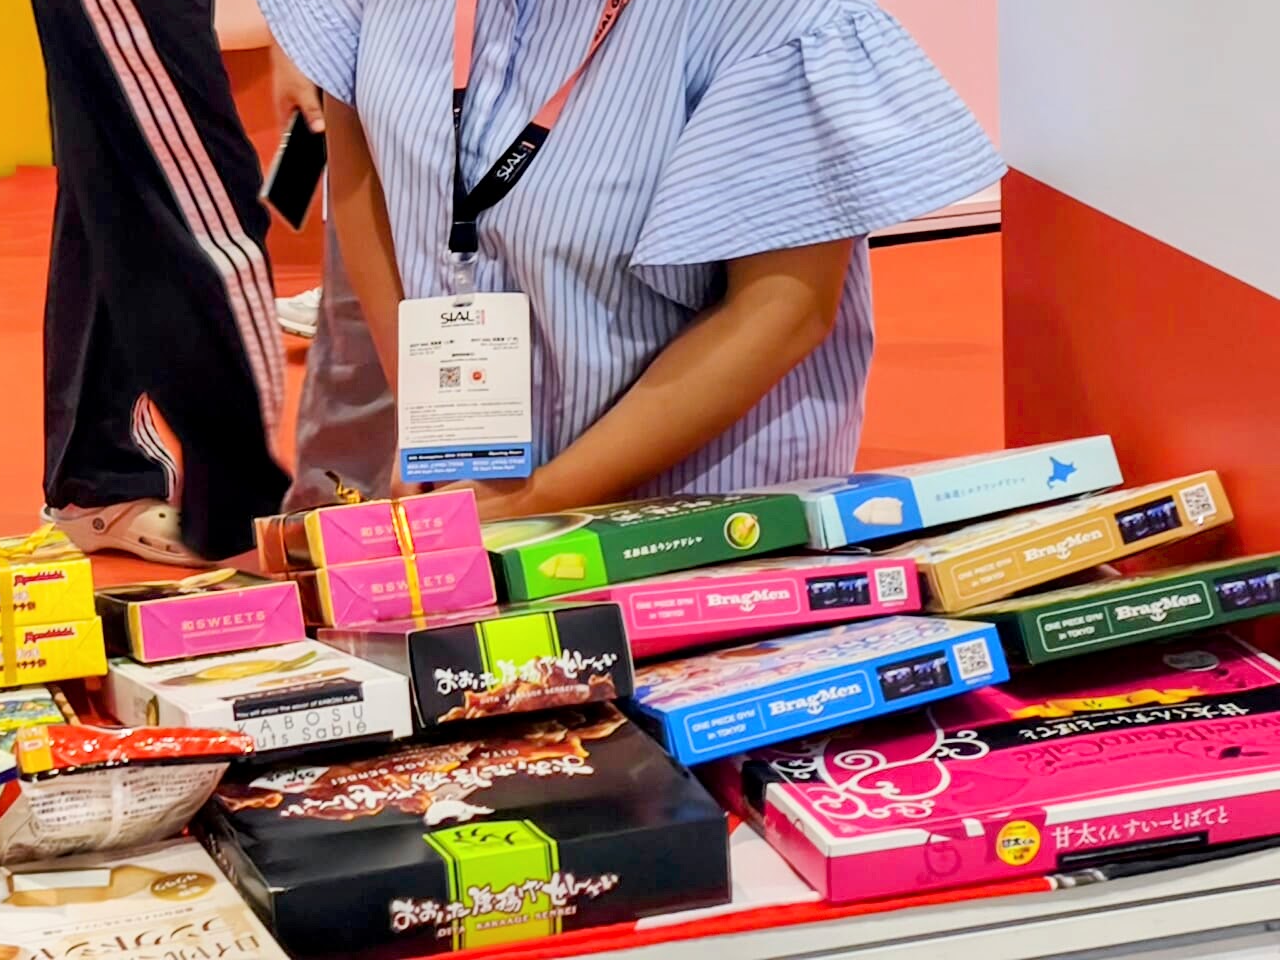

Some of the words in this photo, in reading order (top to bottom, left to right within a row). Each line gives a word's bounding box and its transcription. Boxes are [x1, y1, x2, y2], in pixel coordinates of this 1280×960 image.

[496, 151, 528, 181] SIAL
[440, 311, 475, 325] SIAL
[1023, 530, 1104, 562] BragMen
[706, 588, 791, 612] BragMen
[1114, 593, 1202, 622] BragMen
[768, 683, 862, 716] BragMen
[302, 721, 367, 741] Sable
